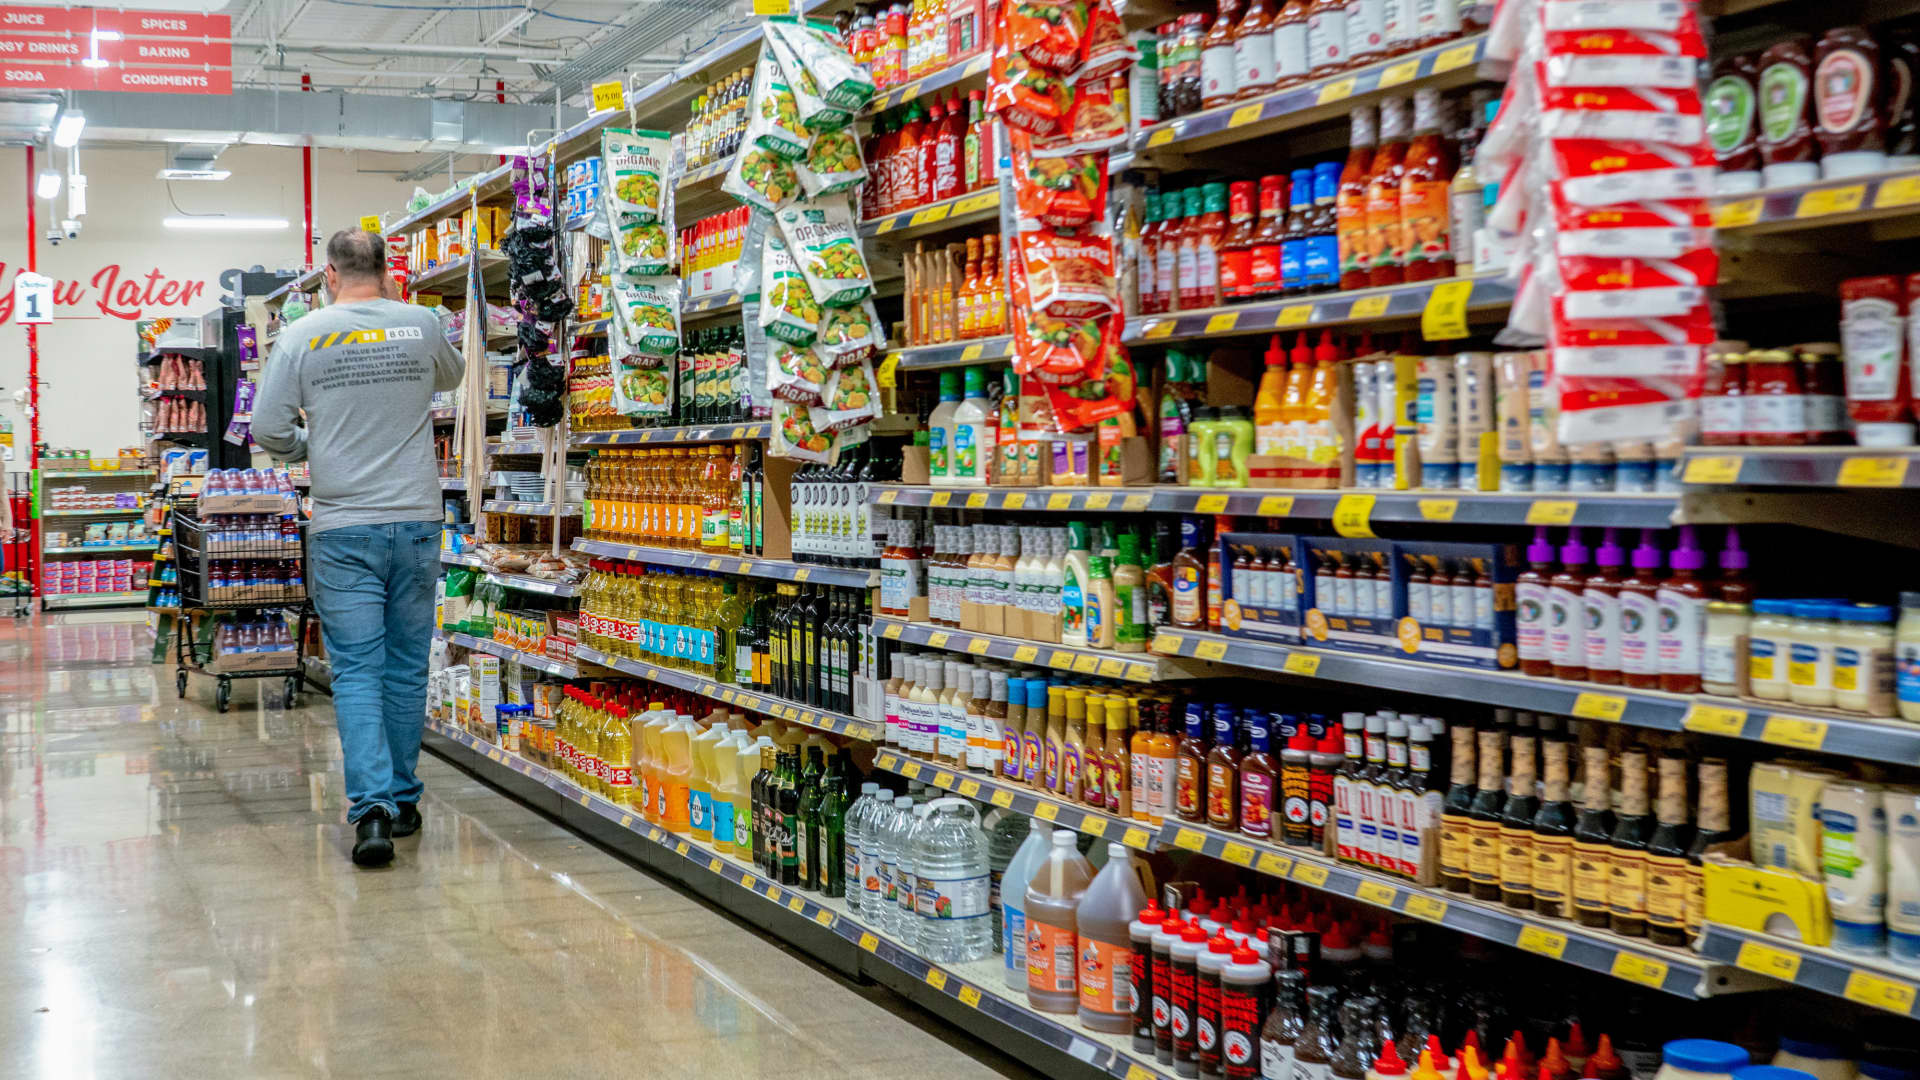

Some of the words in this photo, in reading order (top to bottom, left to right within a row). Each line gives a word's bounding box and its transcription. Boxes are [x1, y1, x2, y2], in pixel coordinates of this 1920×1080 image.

[4, 14, 45, 25] JUICE
[141, 18, 188, 31] SPICES
[29, 42, 79, 54] DRINKS
[139, 46, 190, 58] BAKING
[5, 70, 46, 82] SODA
[121, 73, 208, 87] CONDIMENTS
[616, 155, 660, 171] ORGANIC
[794, 220, 849, 242] ORGANIC
[1056, 246, 1111, 265] PEPPERS
[90, 264, 205, 321] Later
[25, 293, 42, 318] 1
[362, 332, 378, 341] BE
[389, 329, 420, 339] BOLD
[346, 348, 370, 356] VALUE
[371, 345, 400, 354] SAFETY
[344, 354, 391, 364] EVERYTHING
[327, 362, 385, 374] RESPECTFULLY
[311, 373, 350, 387] EXCHANGE
[351, 369, 394, 379] FEEDBACK
[394, 367, 407, 375] AND
[322, 382, 346, 391] SHARE
[347, 379, 371, 387] IDEAS
[372, 375, 404, 385] WITHOUT
